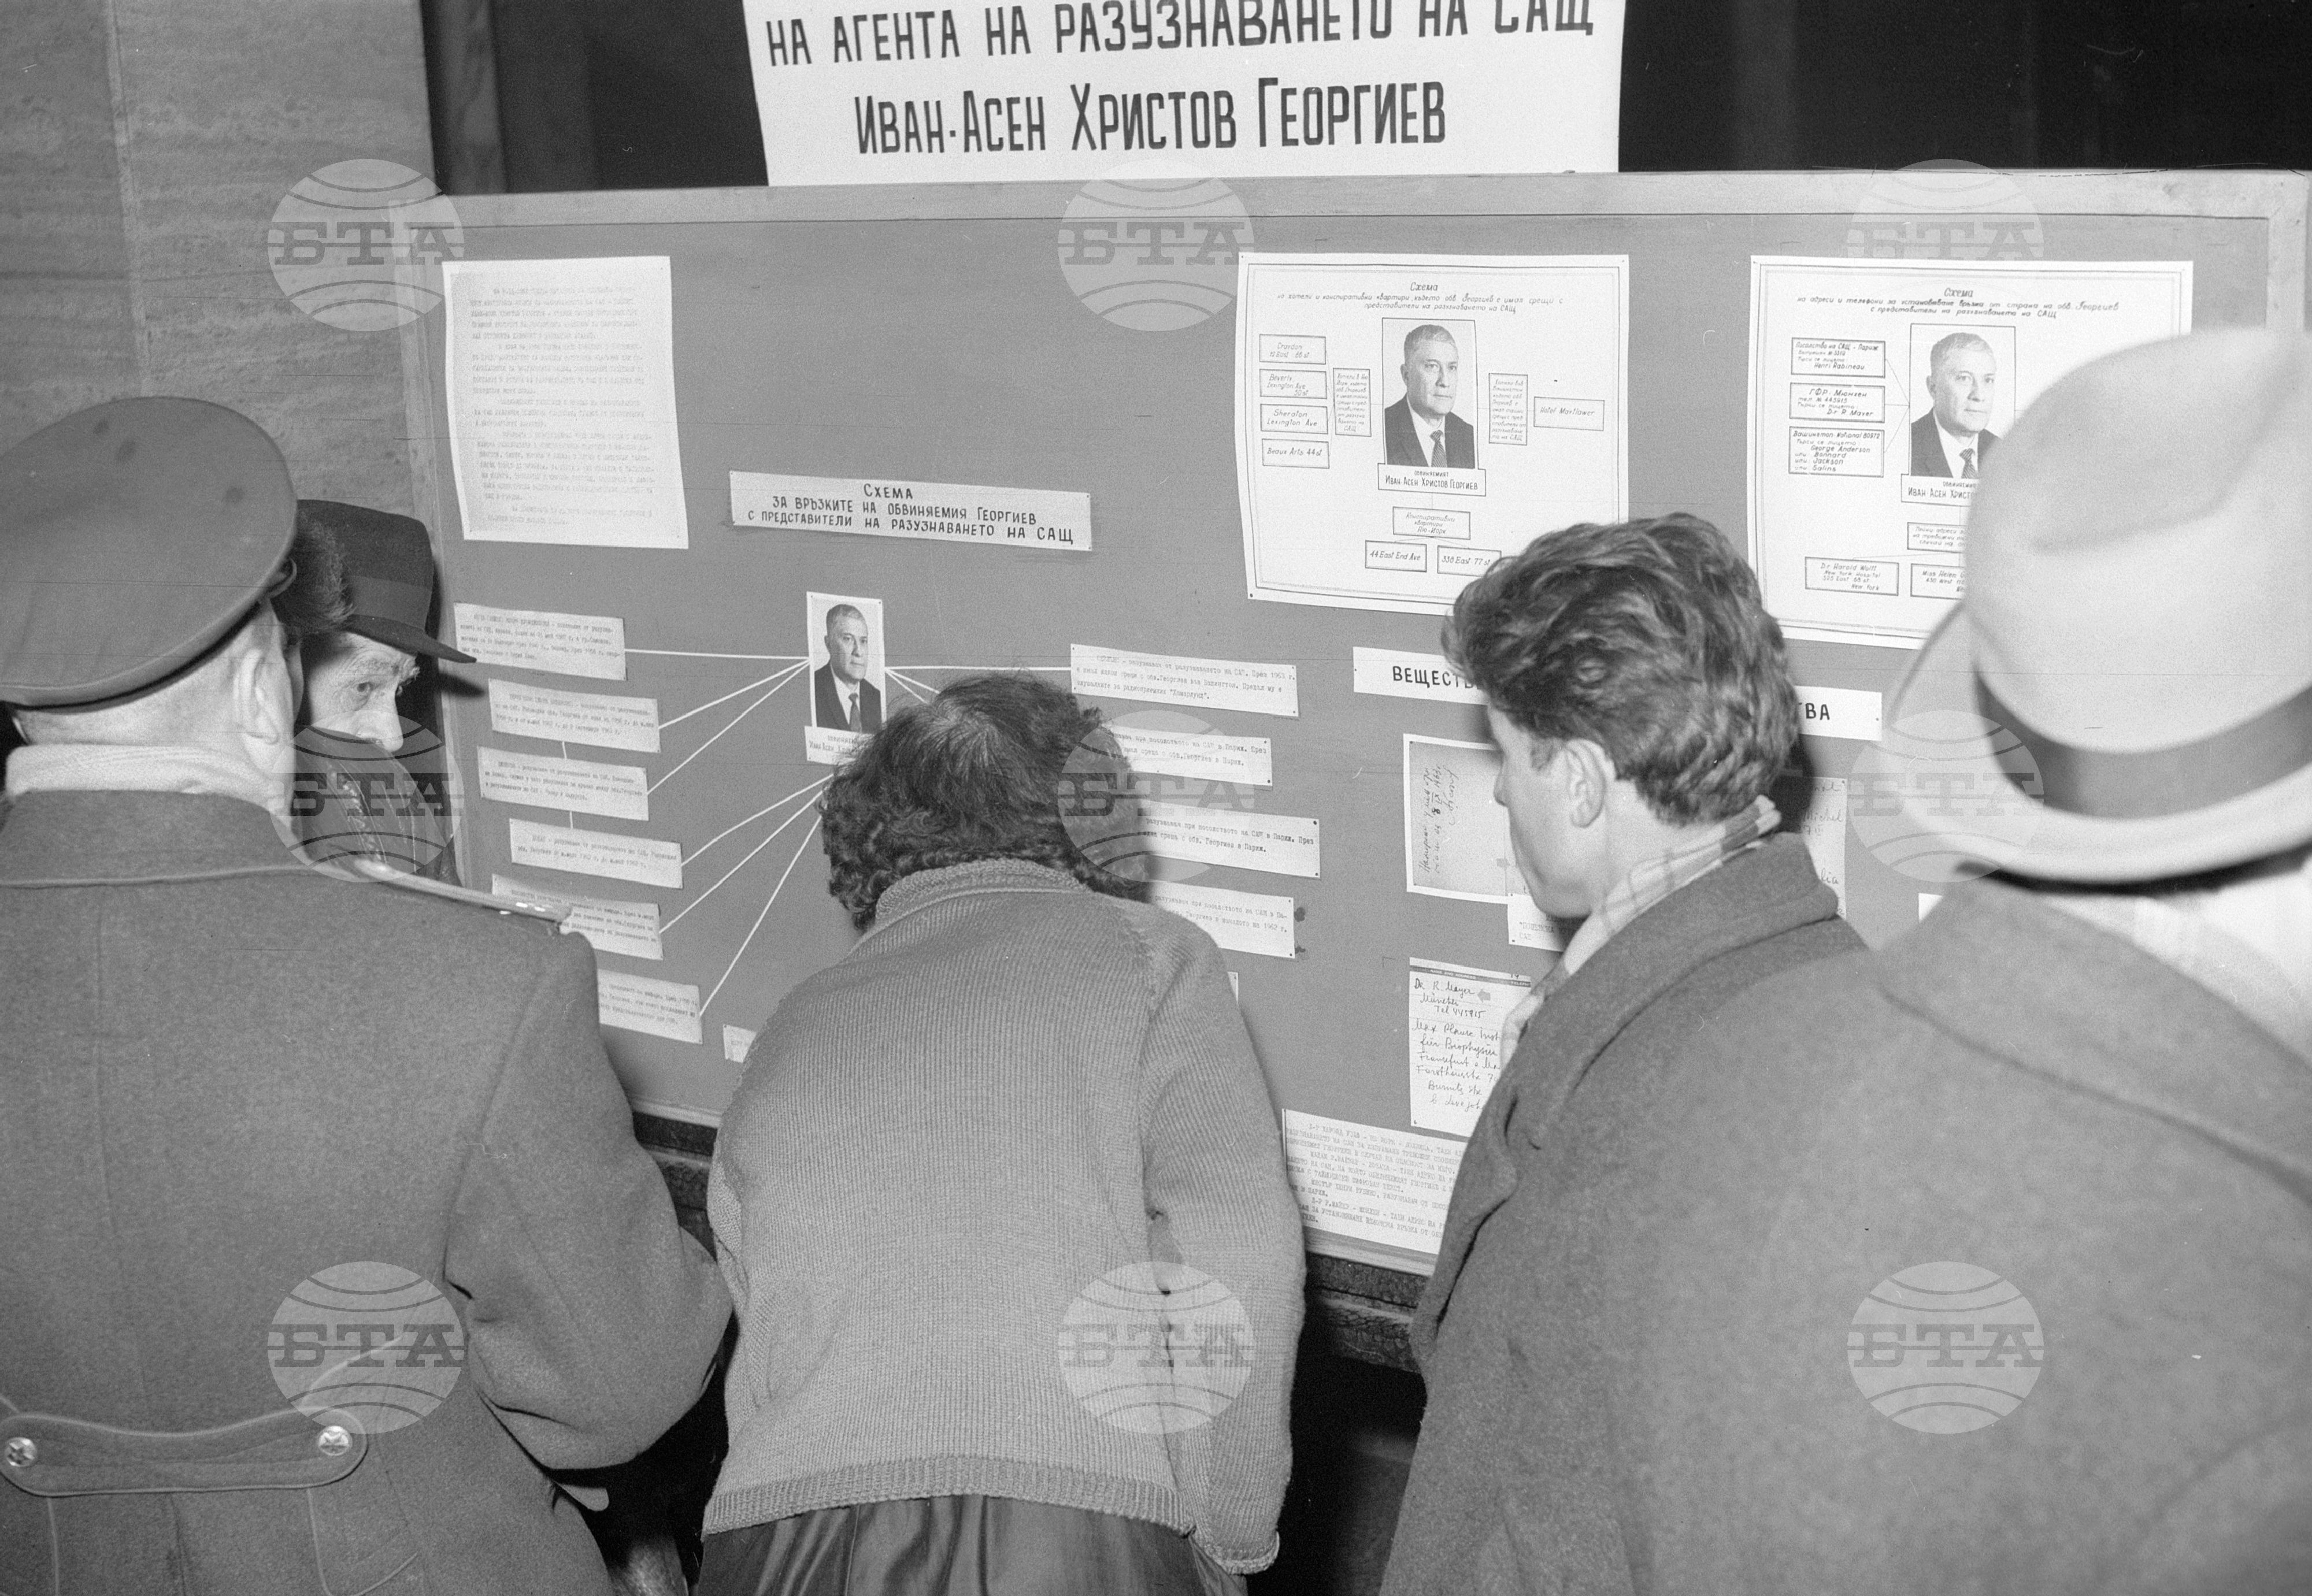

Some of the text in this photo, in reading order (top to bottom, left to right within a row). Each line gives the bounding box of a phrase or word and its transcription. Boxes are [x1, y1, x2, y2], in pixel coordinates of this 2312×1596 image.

[766, 0, 1594, 66] НА АГЕНТА НА РАЗУЗНАВАНЕТО НА САЩ
[1266, 418, 1318, 427] Lexington Ave
[1273, 409, 1308, 418] Sheraton
[772, 495, 788, 508] ЗА
[795, 497, 854, 513] ВРЪЗКИТЕ
[862, 501, 877, 514] НА
[887, 503, 967, 519] ОБВИНЯЕМИЯ
[761, 511, 853, 526] ПРЕДСТАВИТЕЛИ
[864, 518, 880, 528] НА
[891, 519, 995, 536] РАЗУЗНАВАНЕТО
[1006, 526, 1026, 539] НА
[1036, 526, 1074, 545] САЩ
